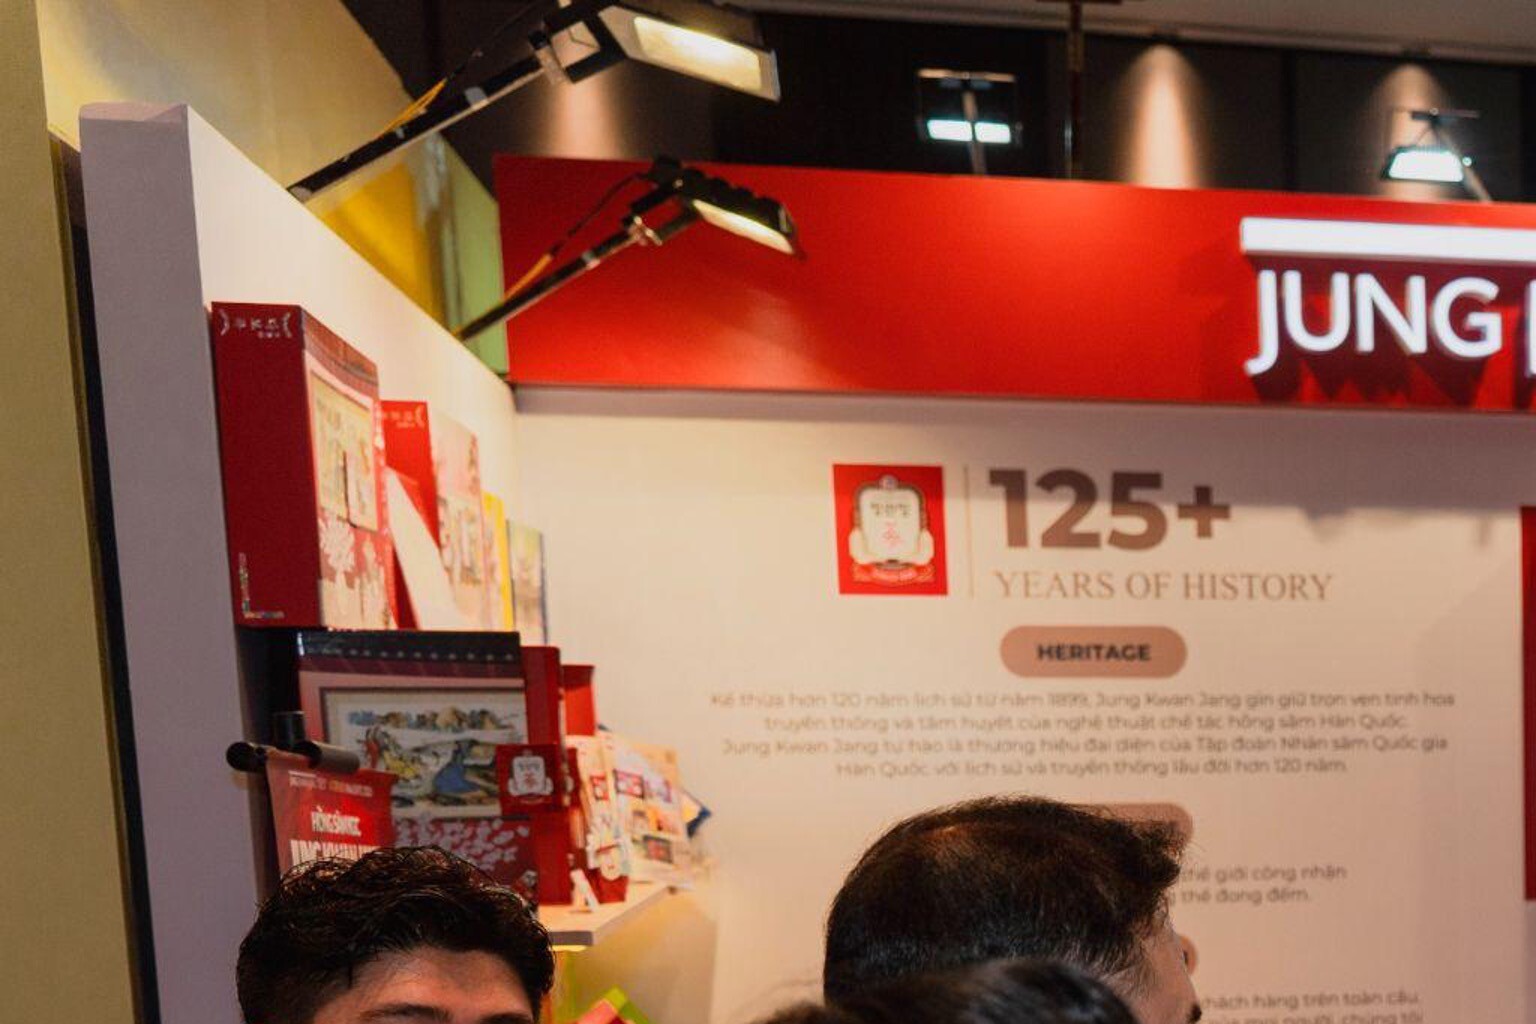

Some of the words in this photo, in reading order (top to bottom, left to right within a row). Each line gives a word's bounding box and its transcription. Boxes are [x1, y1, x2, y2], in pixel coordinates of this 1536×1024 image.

[1244, 268, 1504, 378] JUNG
[988, 467, 1231, 552] 125+
[993, 570, 1116, 600] YEARS
[1125, 571, 1172, 600] OF
[1182, 571, 1334, 601] HISTORY
[1036, 642, 1152, 662] HERITAGE
